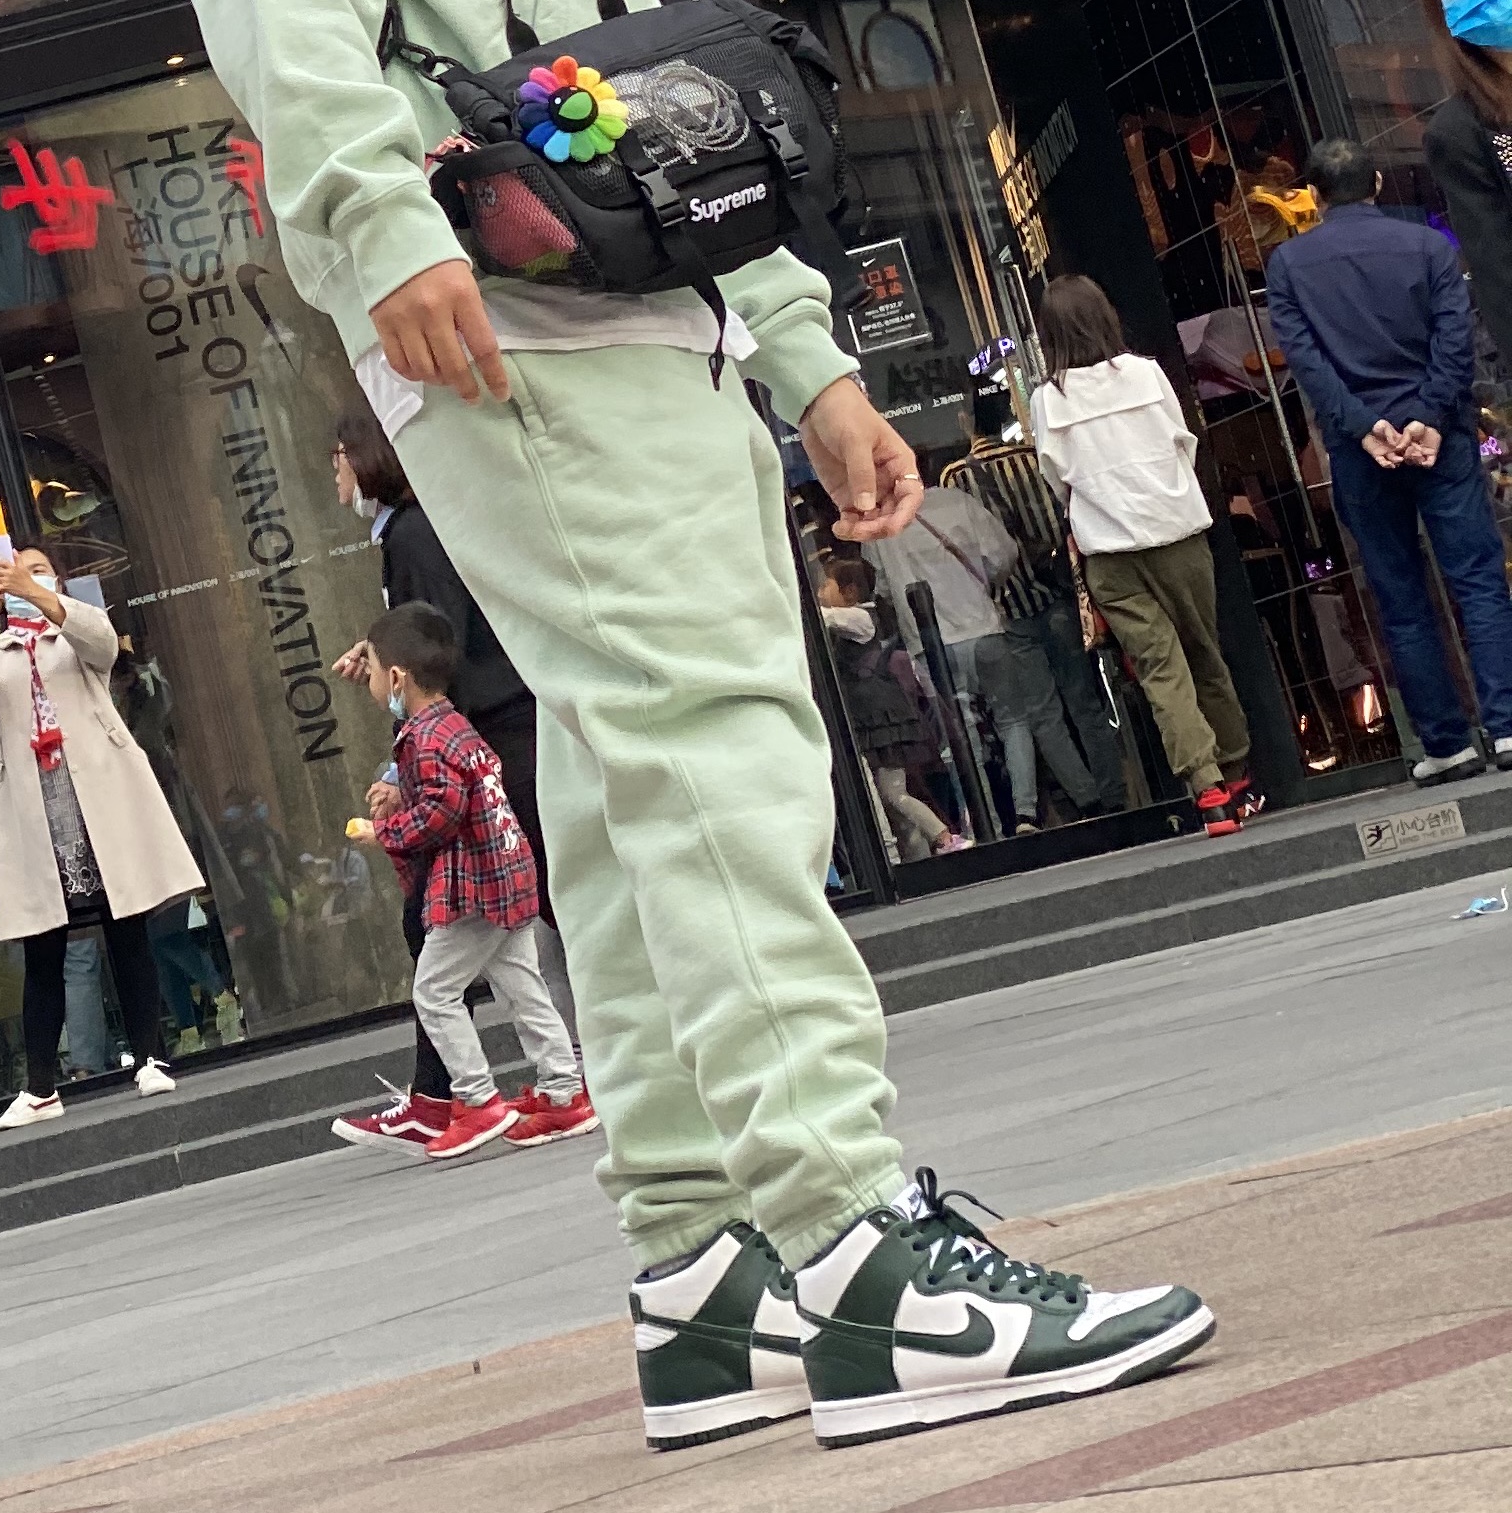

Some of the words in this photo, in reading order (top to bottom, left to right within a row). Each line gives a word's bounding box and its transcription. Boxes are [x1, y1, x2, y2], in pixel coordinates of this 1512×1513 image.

[198, 118, 257, 245] NIKE
[690, 183, 767, 223] Supreme
[147, 125, 236, 325] HOUSE
[104, 149, 190, 362] 上海/001
[202, 336, 259, 409] OF
[978, 384, 999, 396] NIKE
[780, 433, 801, 445] NIKE
[879, 403, 922, 420] NOVATION
[328, 543, 359, 558] HOUSE
[127, 592, 158, 608] HOUSE
[157, 589, 170, 600] OF
[170, 577, 219, 597] INNOVATION
[222, 426, 345, 763] INNOVATION
[1396, 808, 1458, 836] 小心台阶
